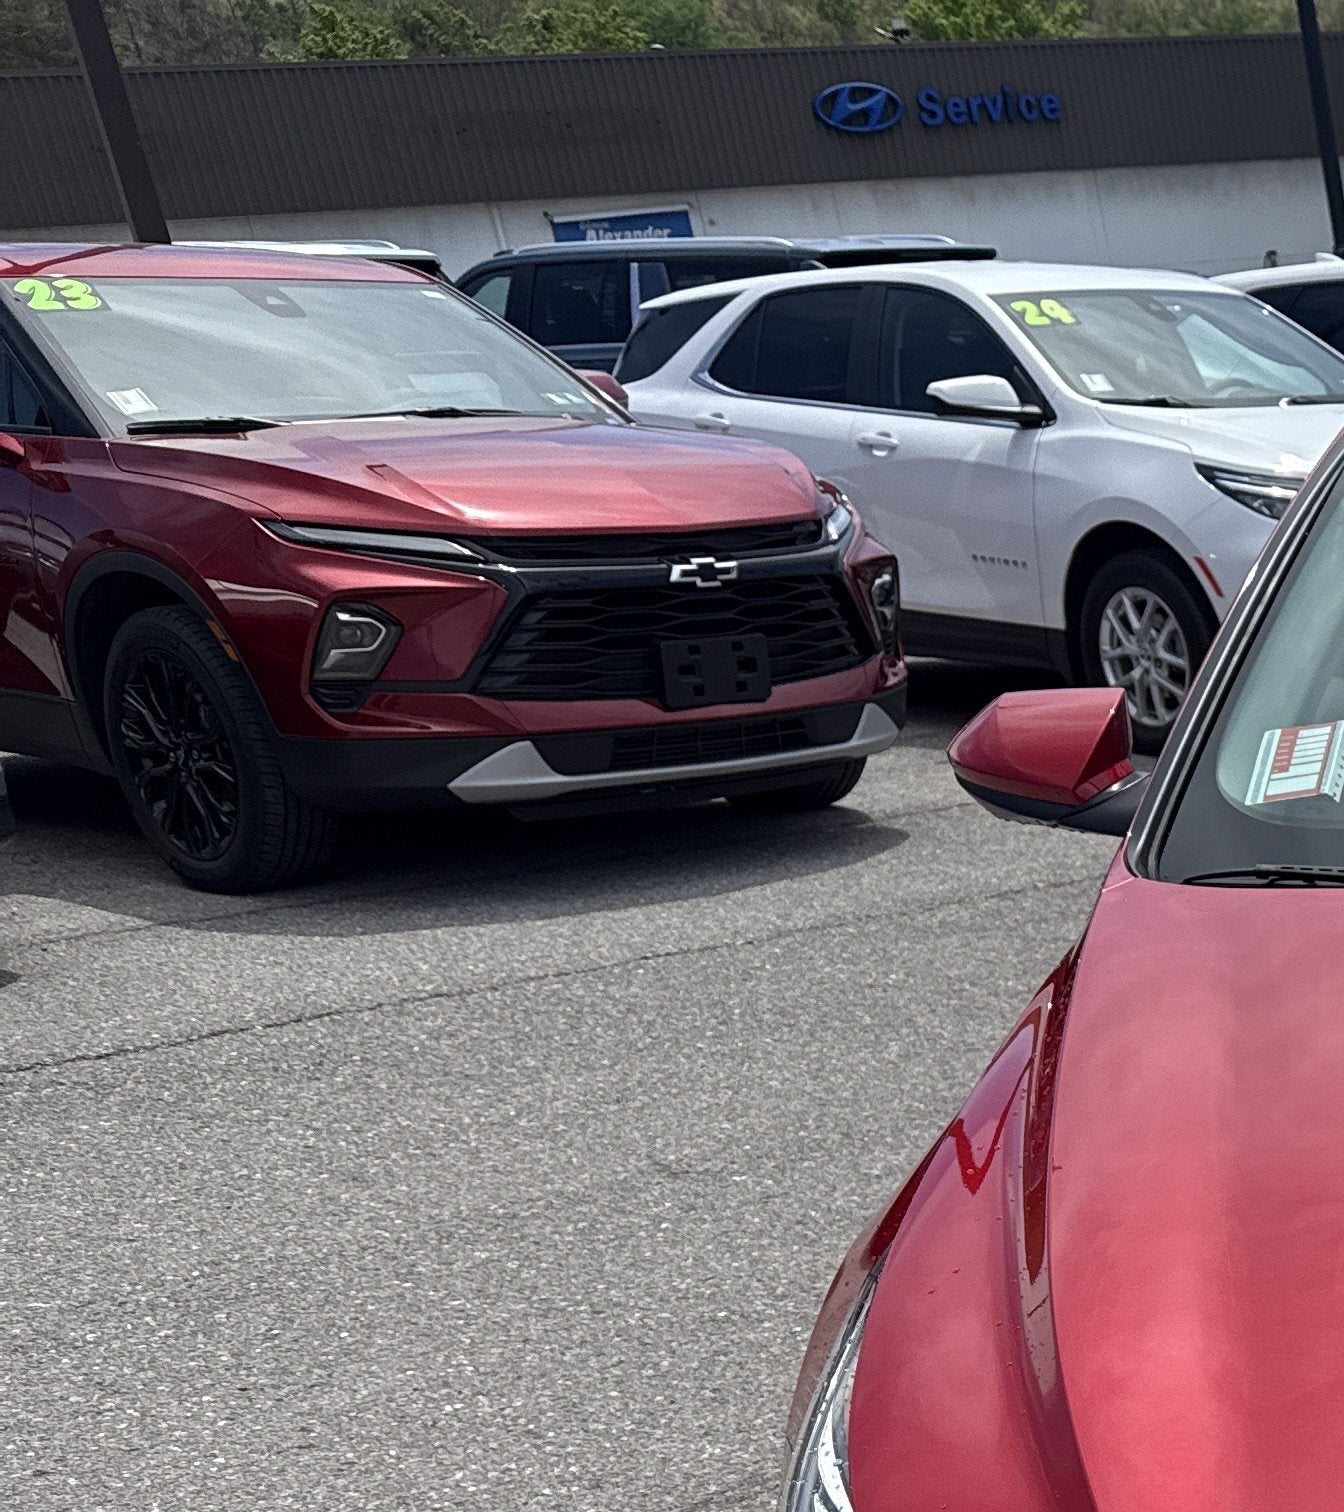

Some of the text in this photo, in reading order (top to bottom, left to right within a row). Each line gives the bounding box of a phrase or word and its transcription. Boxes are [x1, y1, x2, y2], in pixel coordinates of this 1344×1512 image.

[916, 84, 1063, 127] Service
[13, 278, 102, 310] 23
[1009, 298, 1077, 326] 24
